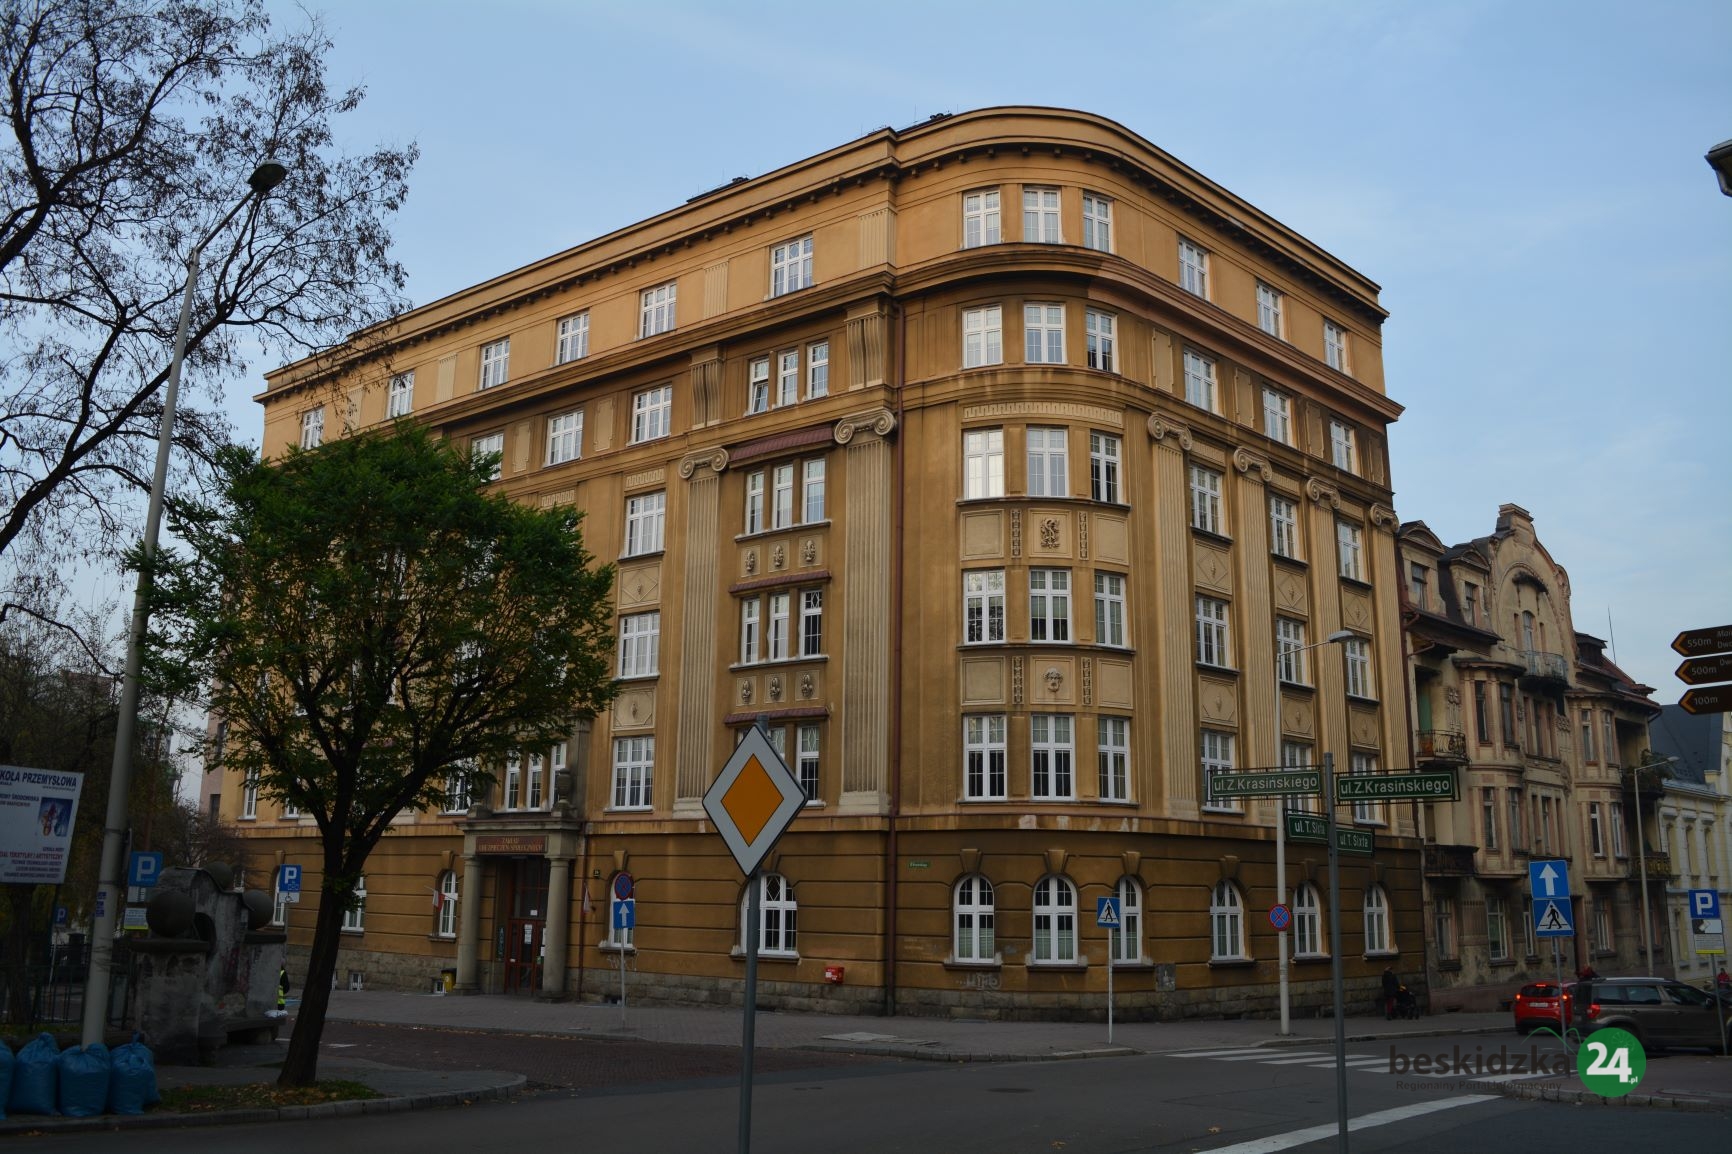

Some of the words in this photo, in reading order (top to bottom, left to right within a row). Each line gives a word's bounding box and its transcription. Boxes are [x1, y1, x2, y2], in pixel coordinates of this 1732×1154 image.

[1687, 638, 1712, 648] 550m
[1691, 666, 1717, 676] 500m
[1694, 696, 1718, 705] 100m
[22, 772, 77, 787] PRZEMYSŁOWA
[137, 856, 155, 882] P
[284, 867, 297, 884] P
[1695, 892, 1713, 915] P
[57, 909, 65, 921] P
